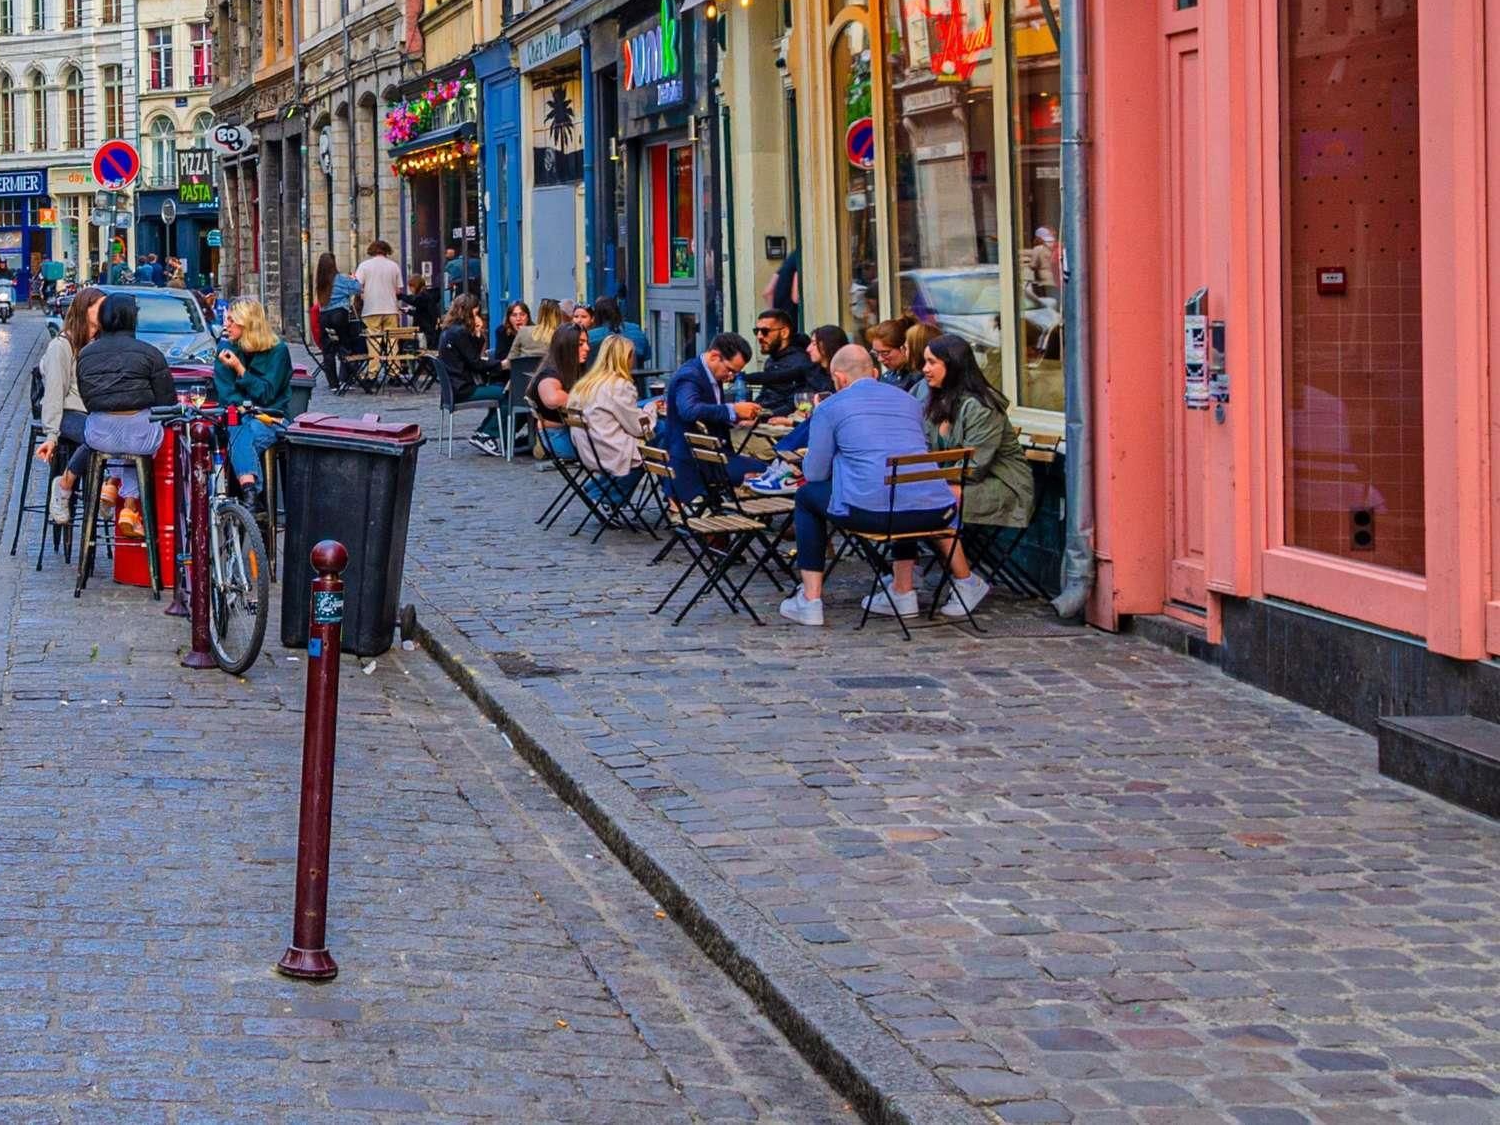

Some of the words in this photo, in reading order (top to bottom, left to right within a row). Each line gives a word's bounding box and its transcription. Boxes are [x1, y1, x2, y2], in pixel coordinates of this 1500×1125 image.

[179, 152, 210, 176] PIZZA
[68, 171, 85, 185] day
[180, 184, 212, 201] PASTA
